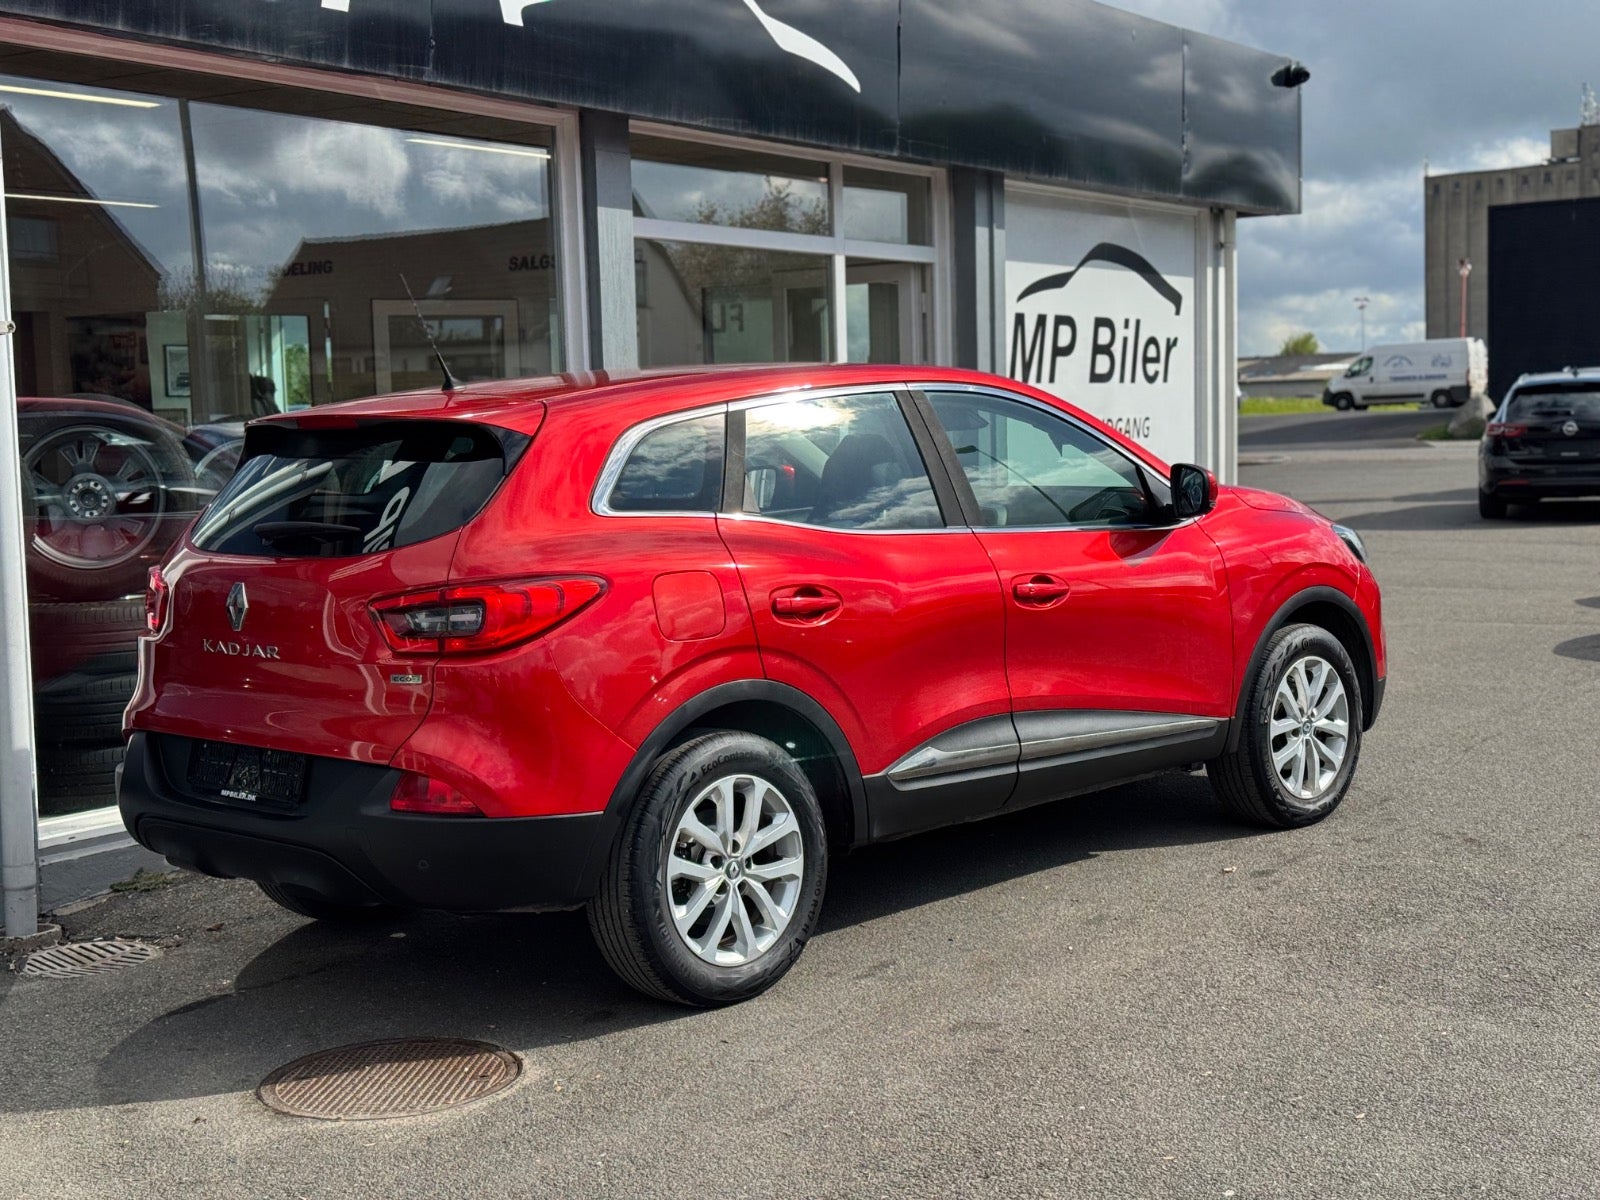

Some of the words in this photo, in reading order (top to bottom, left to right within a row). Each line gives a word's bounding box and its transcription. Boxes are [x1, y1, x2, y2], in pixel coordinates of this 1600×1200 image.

[1009, 312, 1077, 384] MP
[1089, 316, 1179, 385] Biler
[1101, 416, 1151, 438] GANG
[202, 638, 281, 660] KADJAR
